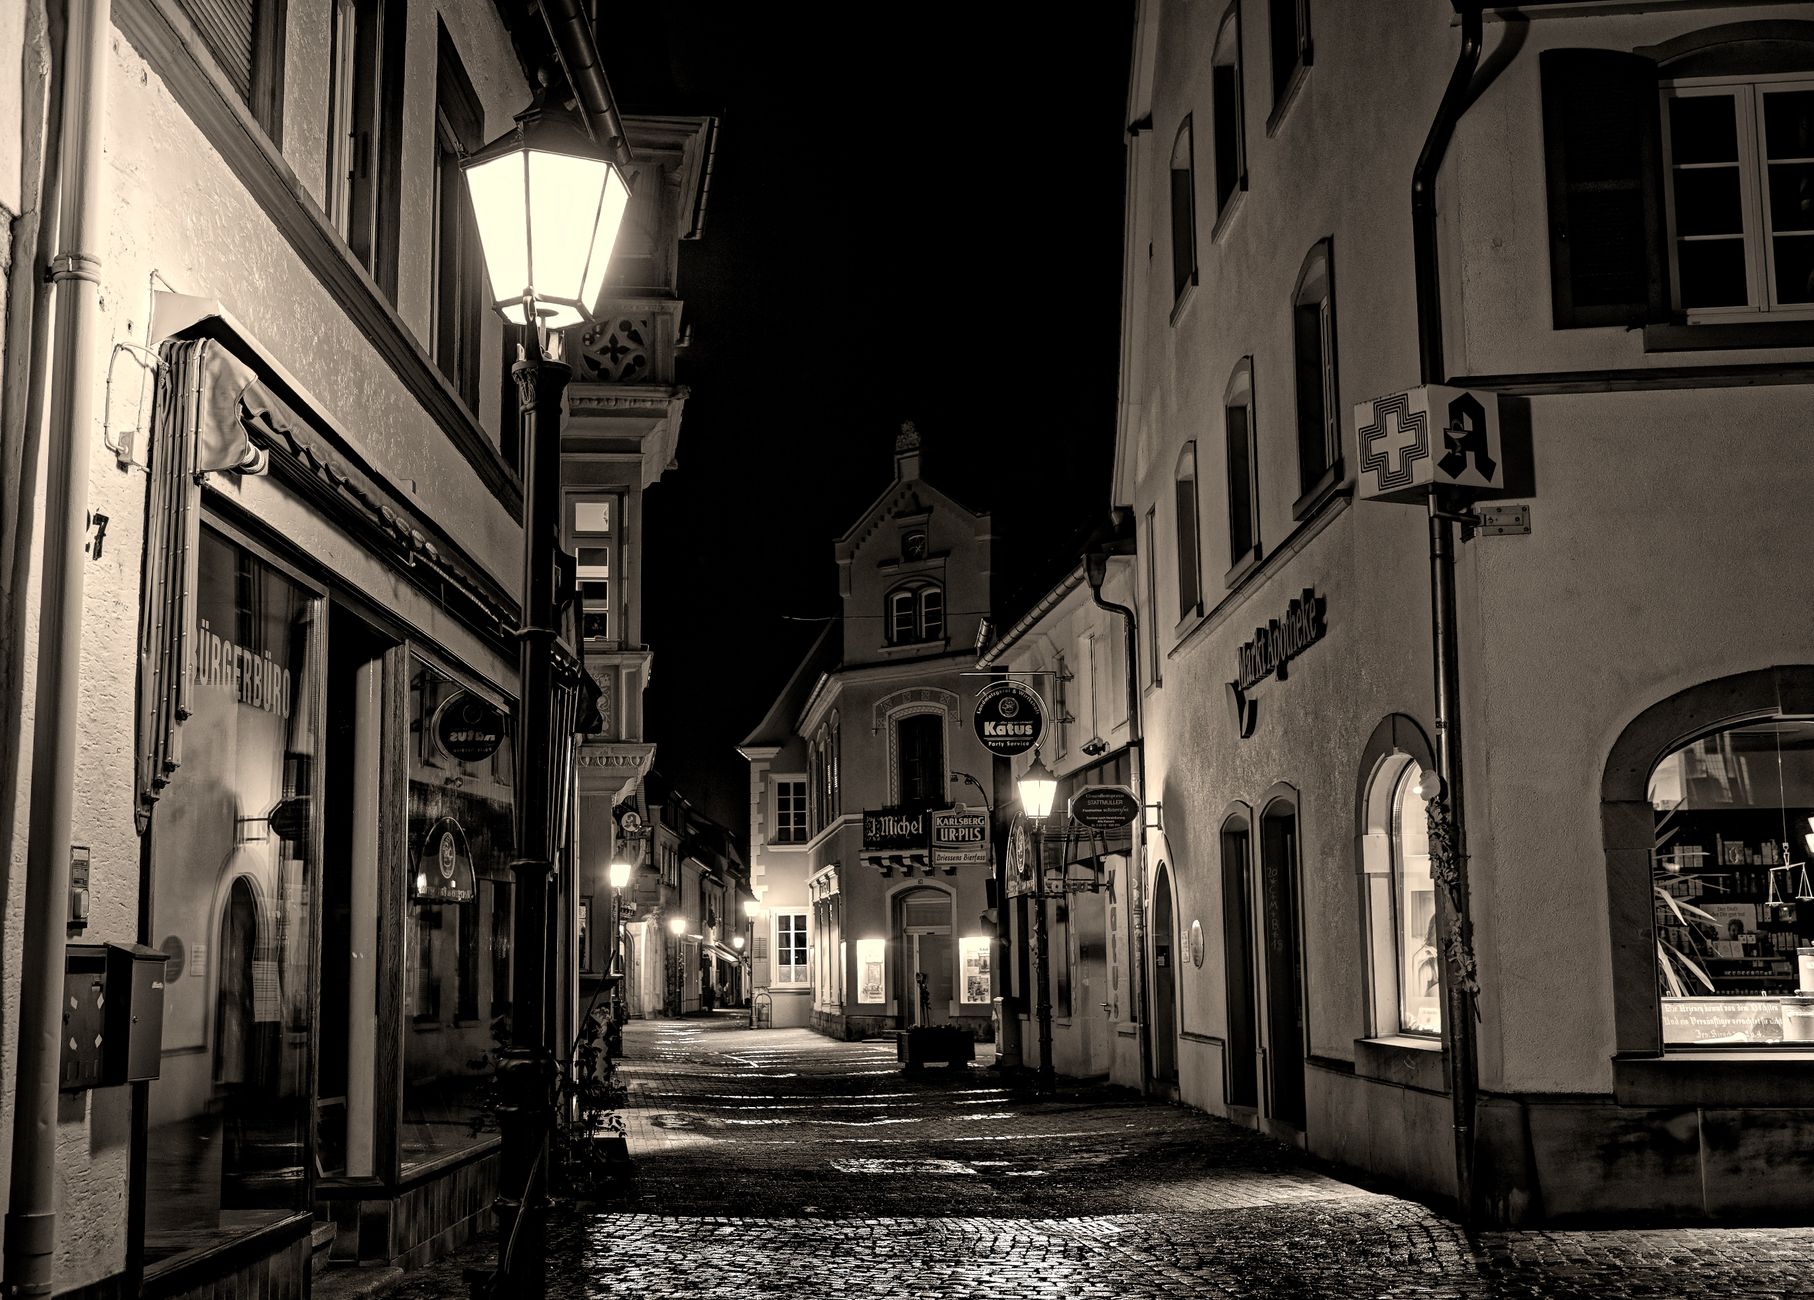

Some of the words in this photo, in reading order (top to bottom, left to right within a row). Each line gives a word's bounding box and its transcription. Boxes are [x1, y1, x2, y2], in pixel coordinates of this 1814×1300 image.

[85, 509, 109, 561] 7
[1267, 592, 1321, 682] Apotheke
[194, 619, 291, 719] ÜRGERBÜRO
[984, 721, 1033, 736] Katus
[880, 815, 923, 839] Michel
[936, 816, 985, 827] KARLSBERG
